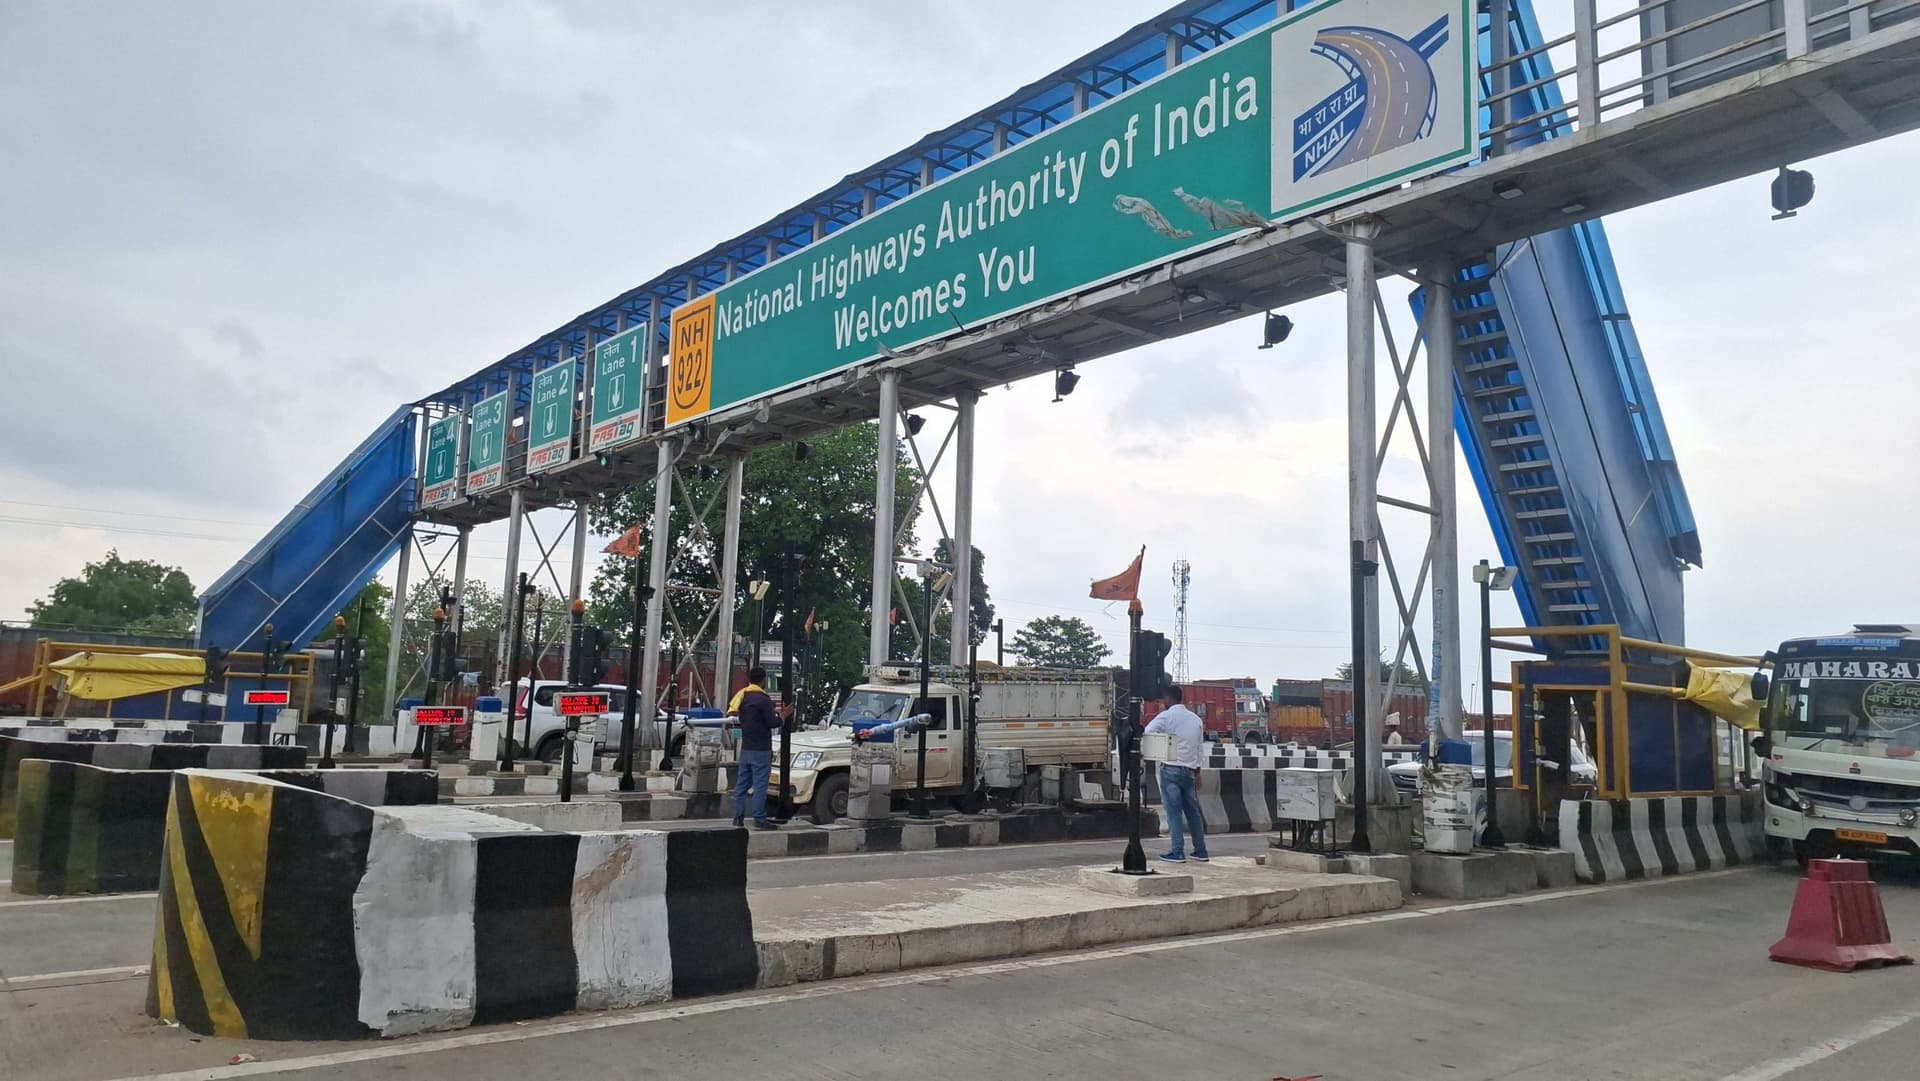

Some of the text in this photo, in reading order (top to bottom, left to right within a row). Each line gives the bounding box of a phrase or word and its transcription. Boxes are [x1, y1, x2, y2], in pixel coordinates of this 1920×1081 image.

[1298, 83, 1359, 136] भा रा रा प्रा
[1304, 121, 1346, 169] NHAI
[717, 72, 1258, 340] National Highways Authority of India
[834, 246, 1035, 350] Welcomes You
[680, 317, 704, 350] NH
[602, 335, 638, 375] Lane 1
[677, 349, 702, 393] 922
[537, 368, 569, 404] Lane 2
[446, 421, 455, 443] 4
[475, 400, 502, 432] Lane 3
